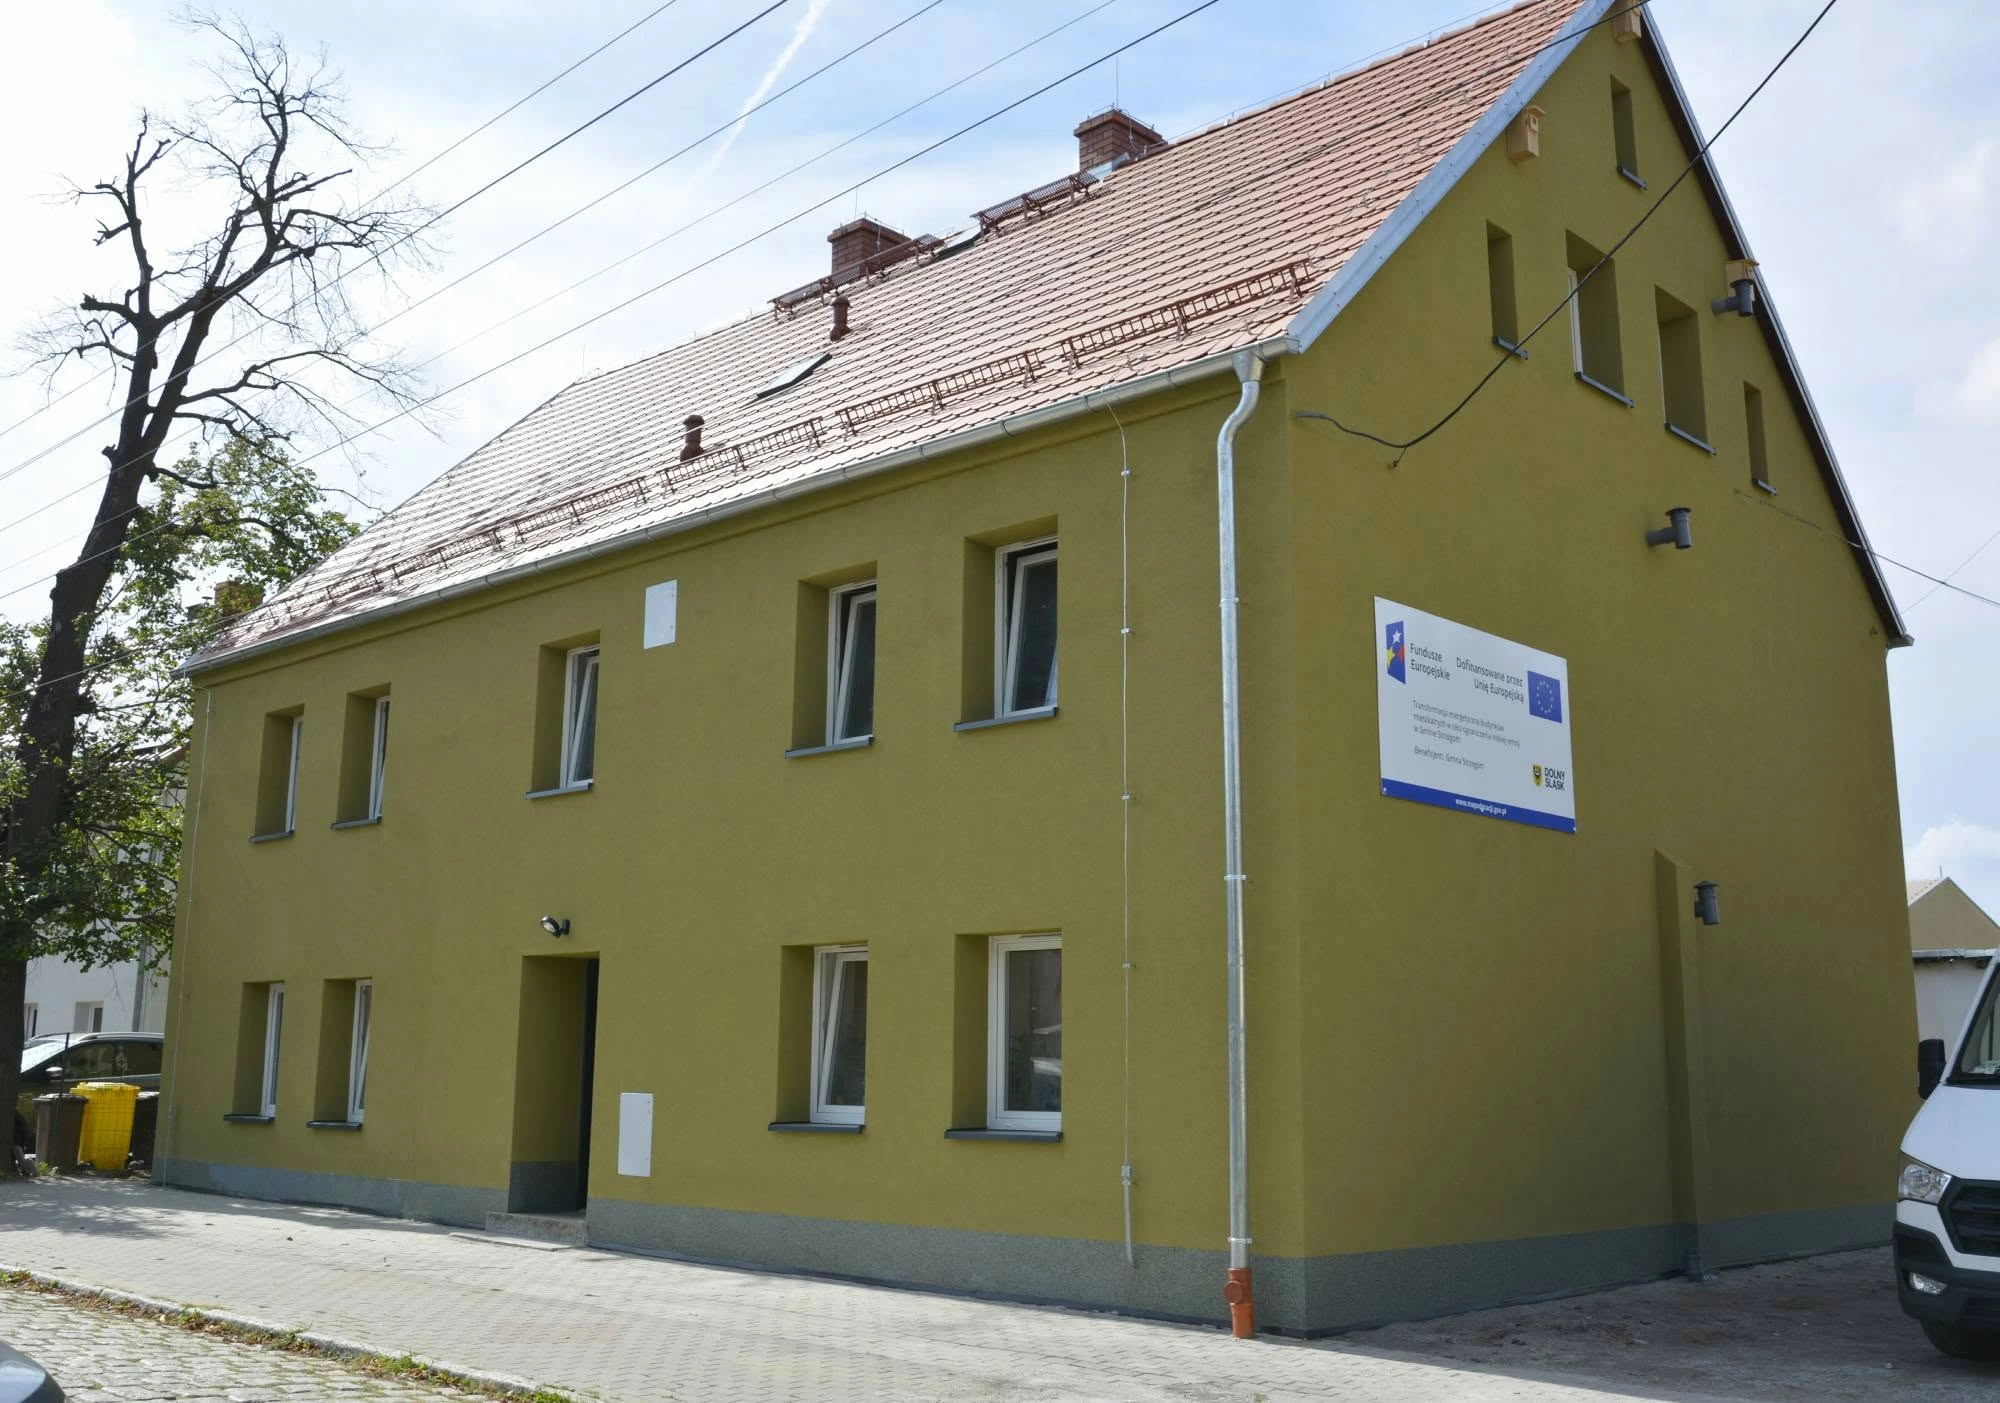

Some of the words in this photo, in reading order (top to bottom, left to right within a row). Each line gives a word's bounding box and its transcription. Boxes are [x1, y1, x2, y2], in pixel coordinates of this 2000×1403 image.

[1410, 643, 1442, 662] Fundusze
[1410, 659, 1450, 680] Europejskie
[1456, 657, 1505, 681] Dofinansowane
[1506, 674, 1523, 687] przez
[1474, 678, 1489, 694] Unię
[1490, 683, 1524, 704] Europejską
[1544, 767, 1565, 780] DOLNY
[1545, 777, 1565, 791] ŚLĄSK
